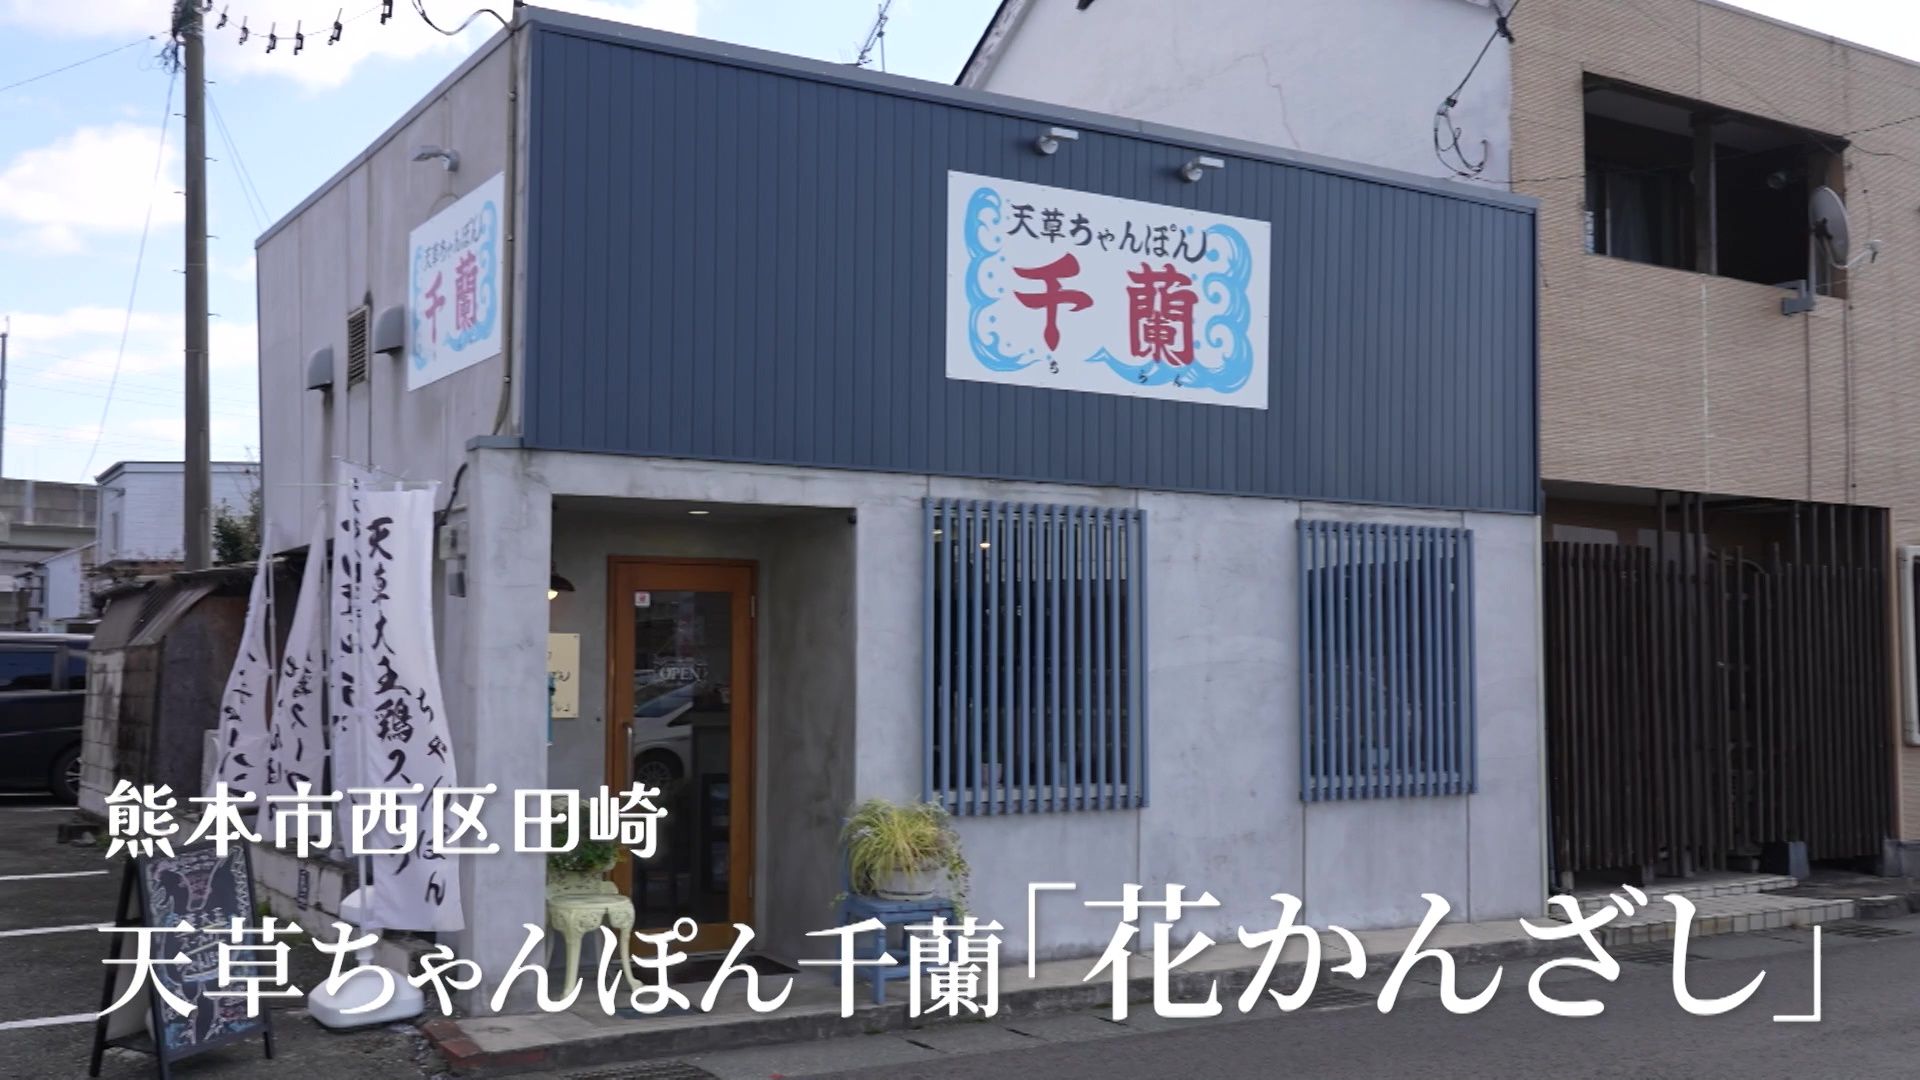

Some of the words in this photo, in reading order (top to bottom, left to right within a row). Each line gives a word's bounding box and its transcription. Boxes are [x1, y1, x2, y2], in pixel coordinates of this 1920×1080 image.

[1007, 203, 1208, 264] 天草ちゃんぽん
[1012, 252, 1199, 366] 千蘭
